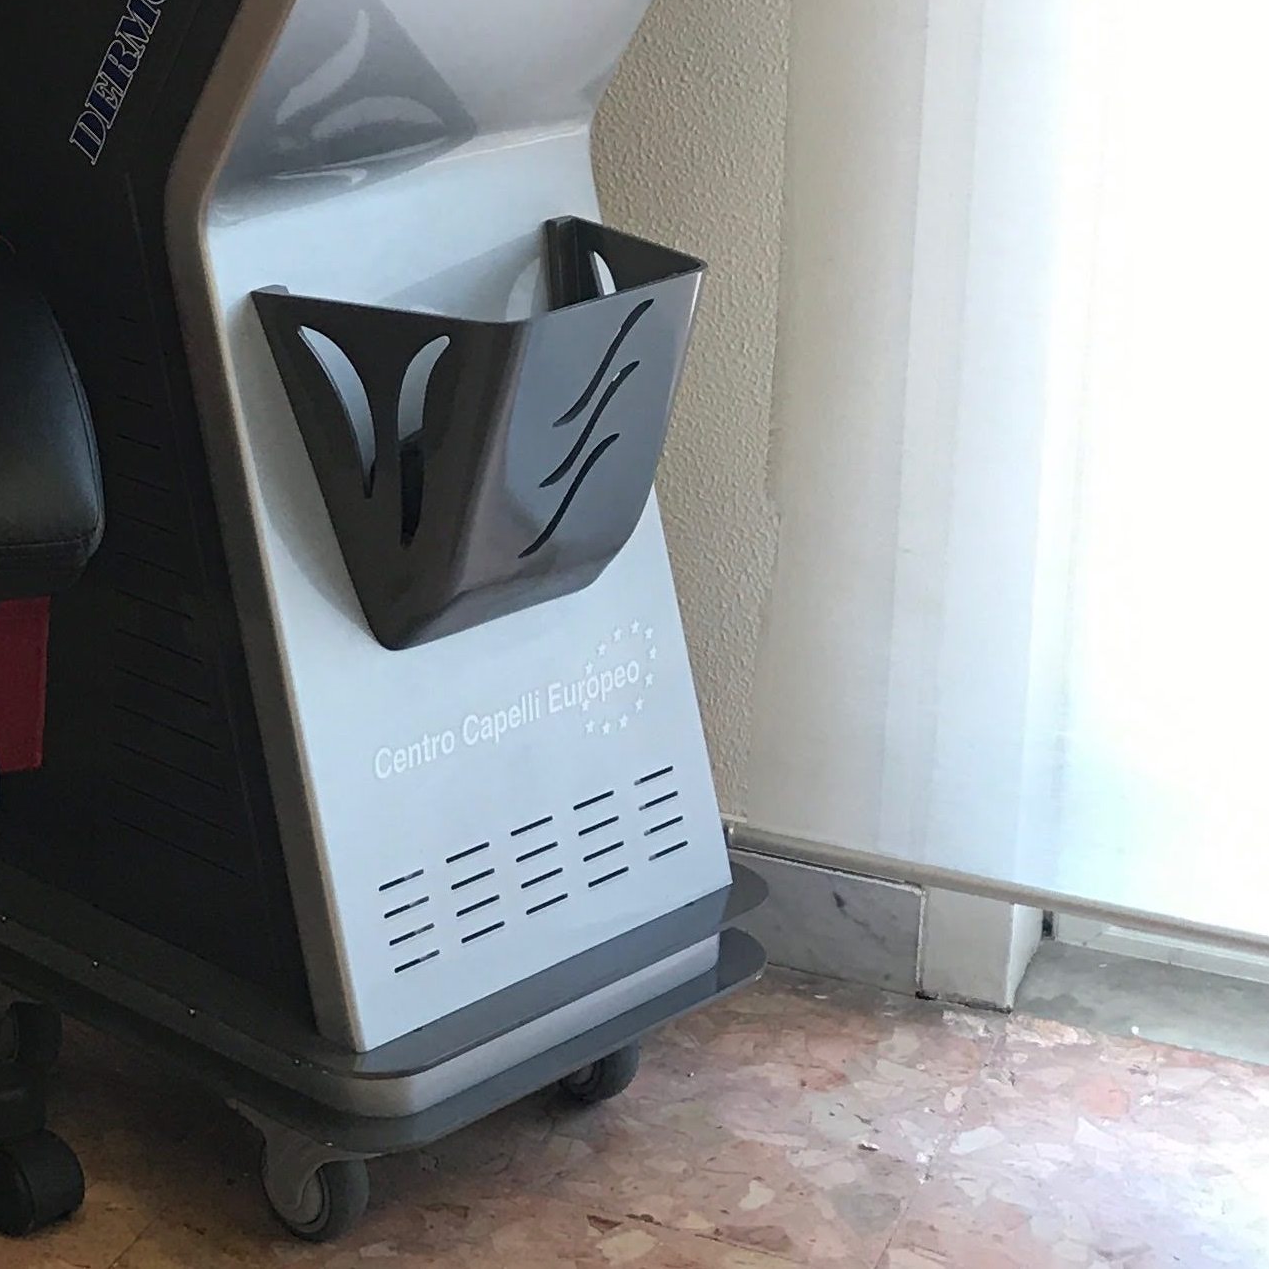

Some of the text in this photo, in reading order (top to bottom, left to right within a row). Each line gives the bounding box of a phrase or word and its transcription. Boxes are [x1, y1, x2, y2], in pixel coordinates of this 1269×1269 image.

[374, 659, 640, 779] Centro Capelli Europeo
